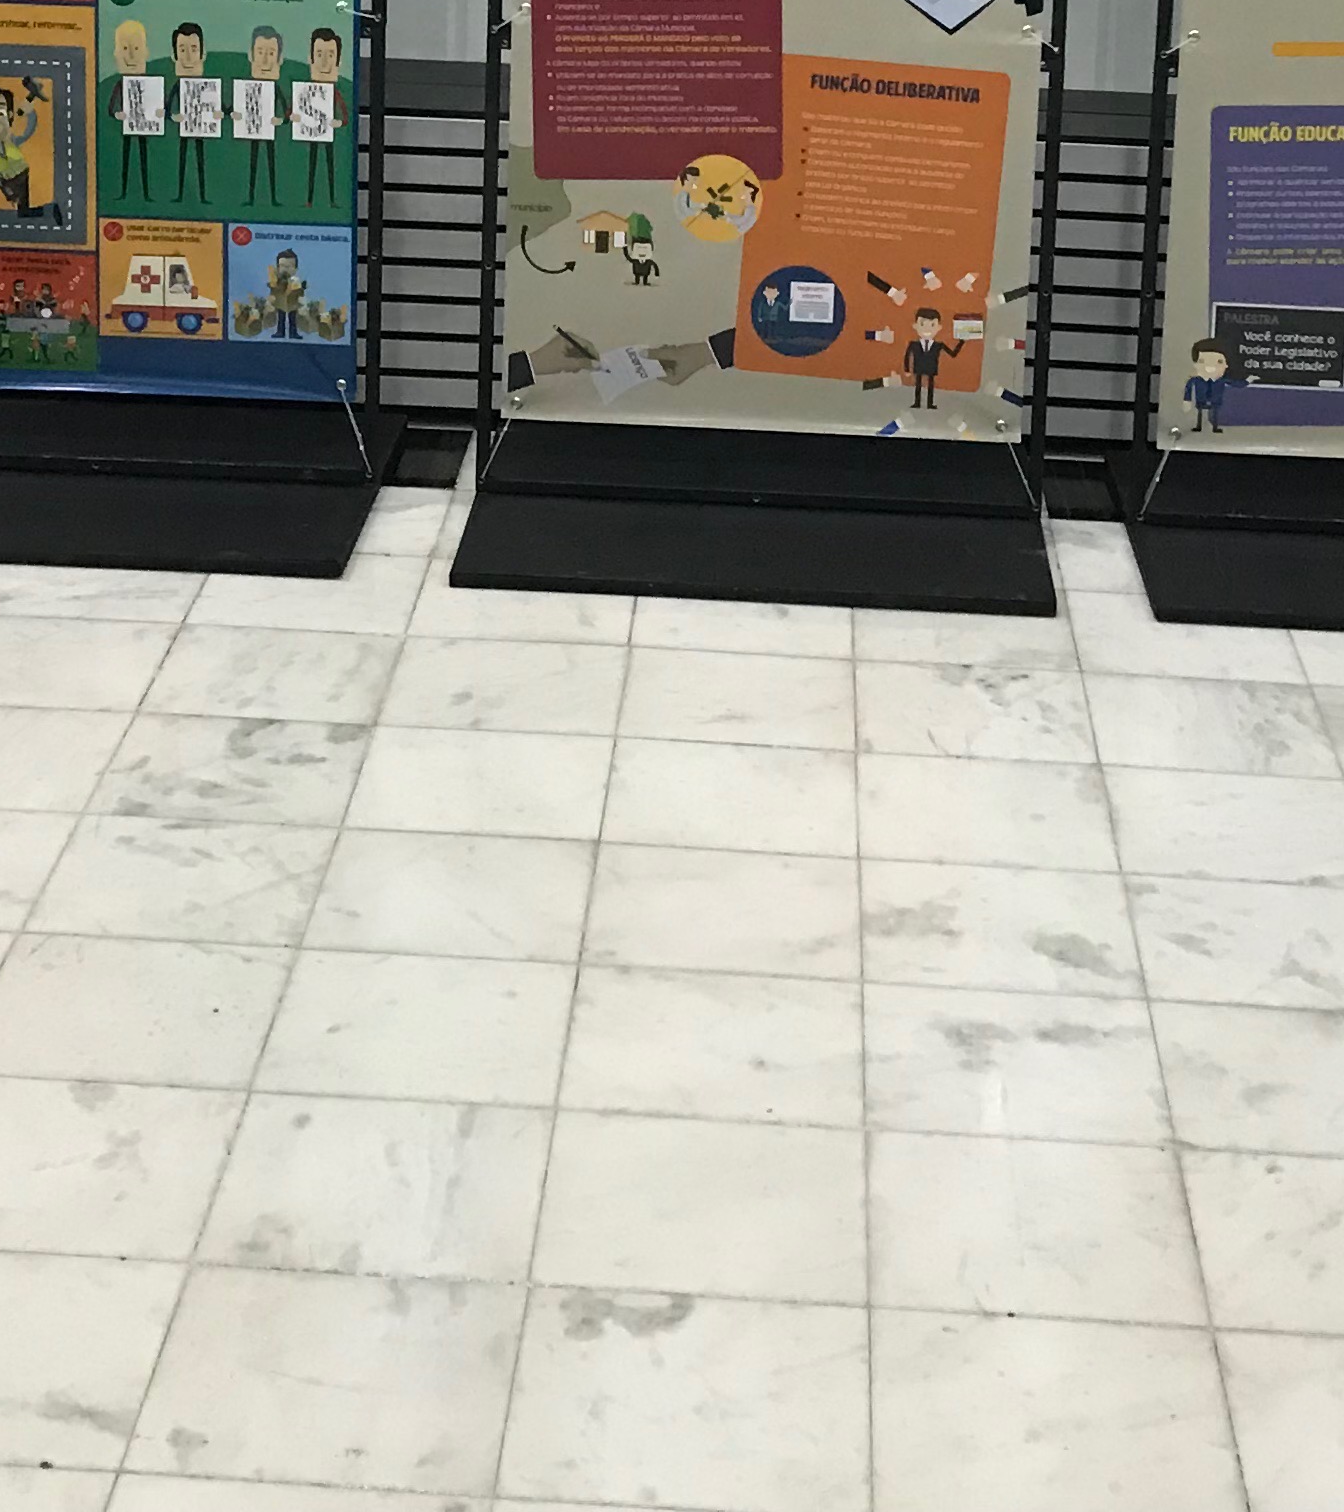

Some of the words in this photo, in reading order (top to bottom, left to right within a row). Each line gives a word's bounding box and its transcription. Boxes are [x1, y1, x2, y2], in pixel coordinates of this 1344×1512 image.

[809, 72, 871, 94] FUNÇÃO
[875, 78, 981, 104] DELIBERATIVA
[1228, 121, 1293, 144] FUNÇÃO
[1223, 311, 1280, 326] PALESTRA
[1244, 330, 1272, 342] Você
[1274, 332, 1324, 344] conhece
[1326, 336, 1336, 344] o
[1239, 344, 1272, 356] Poder
[1274, 345, 1338, 360] Legislativo
[1244, 358, 1260, 369] da
[1262, 360, 1284, 370] sua
[1286, 360, 1332, 372] cidade?
